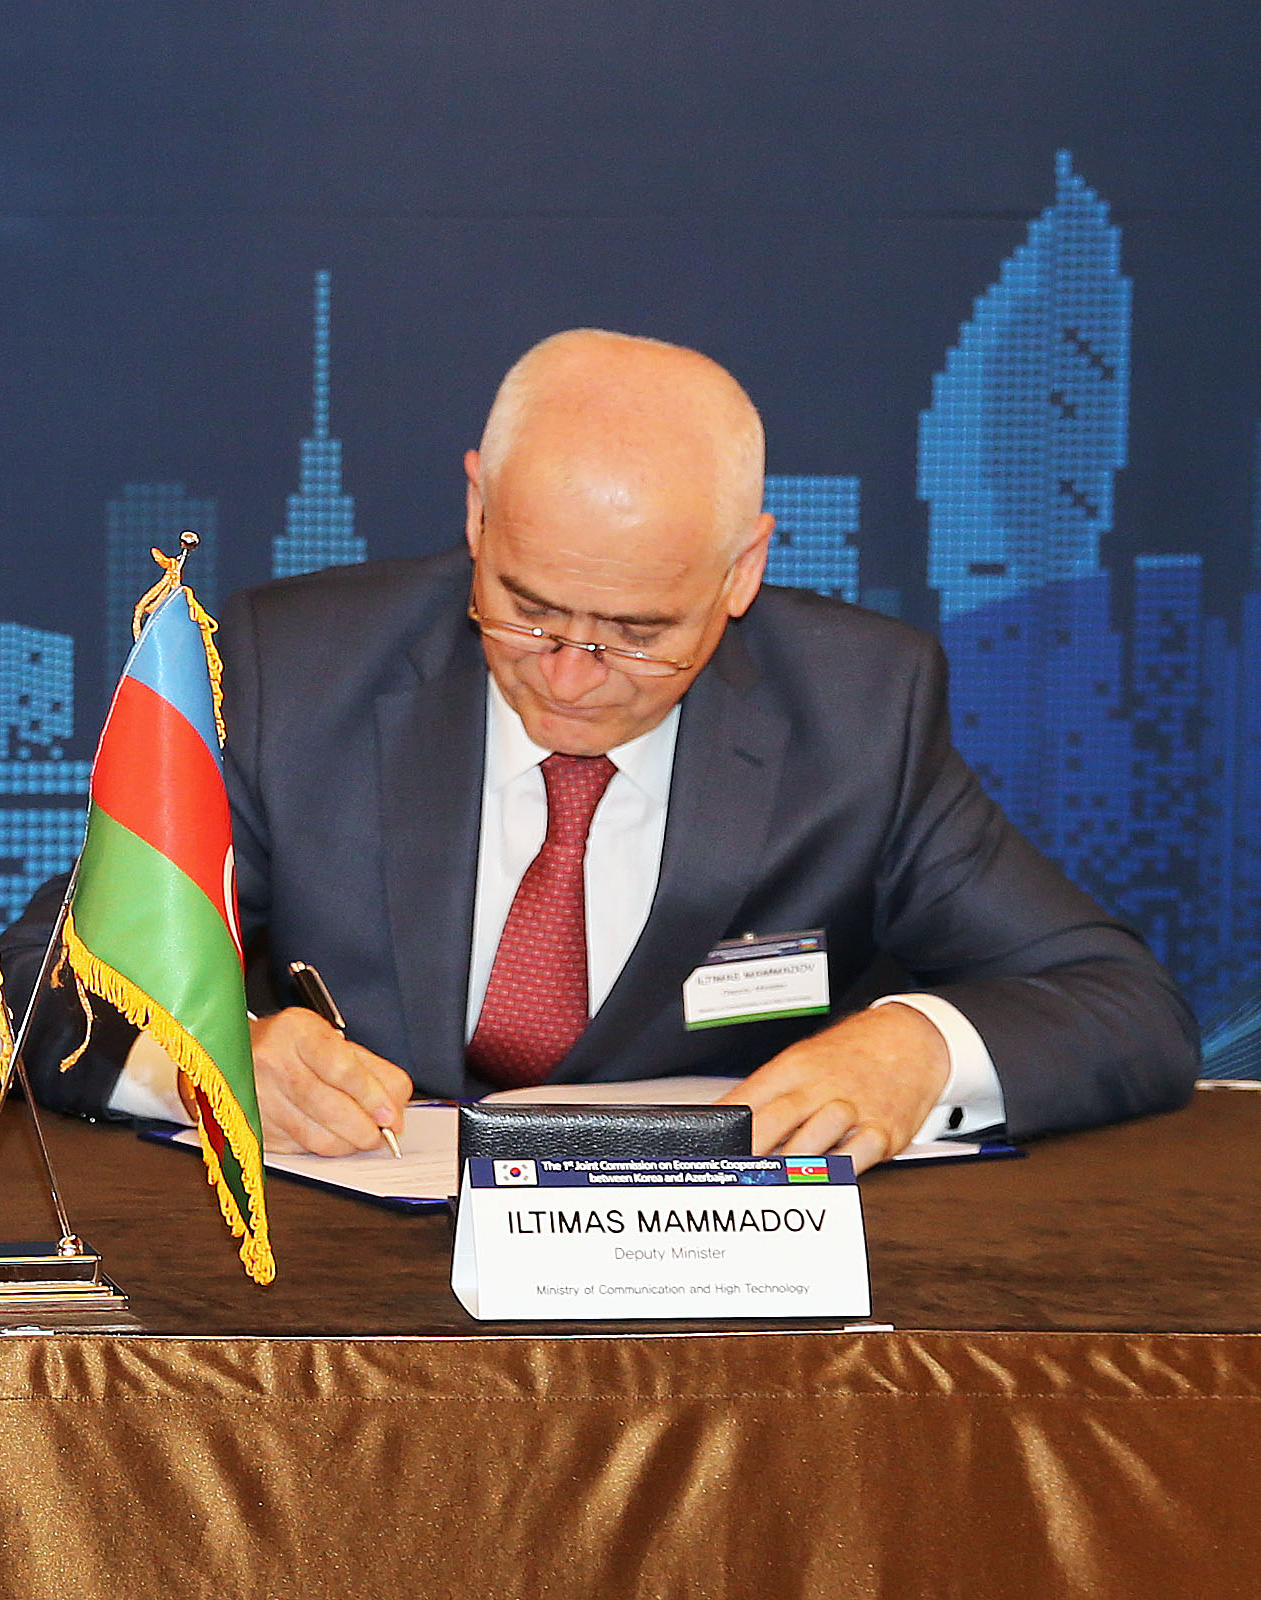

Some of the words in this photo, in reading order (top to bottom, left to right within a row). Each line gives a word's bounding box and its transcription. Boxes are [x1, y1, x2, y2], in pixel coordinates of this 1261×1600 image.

[541, 1160, 561, 1171] The
[575, 1160, 599, 1171] Joint
[599, 1159, 653, 1171] Commission
[658, 1160, 673, 1171] on
[673, 1159, 720, 1170] Economic
[720, 1159, 782, 1172] Cooperation
[588, 1173, 633, 1184] between
[633, 1172, 663, 1184] Korea
[664, 1172, 684, 1183] and
[684, 1172, 738, 1185] Azerbaijan
[508, 1210, 626, 1234] ILTIMAS
[638, 1208, 826, 1233] MAMMADOV
[614, 1247, 665, 1262] Deputy
[671, 1246, 726, 1260] Minister
[537, 1285, 579, 1297] Ministry
[584, 1285, 595, 1295] of
[599, 1284, 686, 1295] Communication
[690, 1284, 711, 1294] and
[715, 1283, 741, 1295] High
[745, 1282, 810, 1295] Technology
